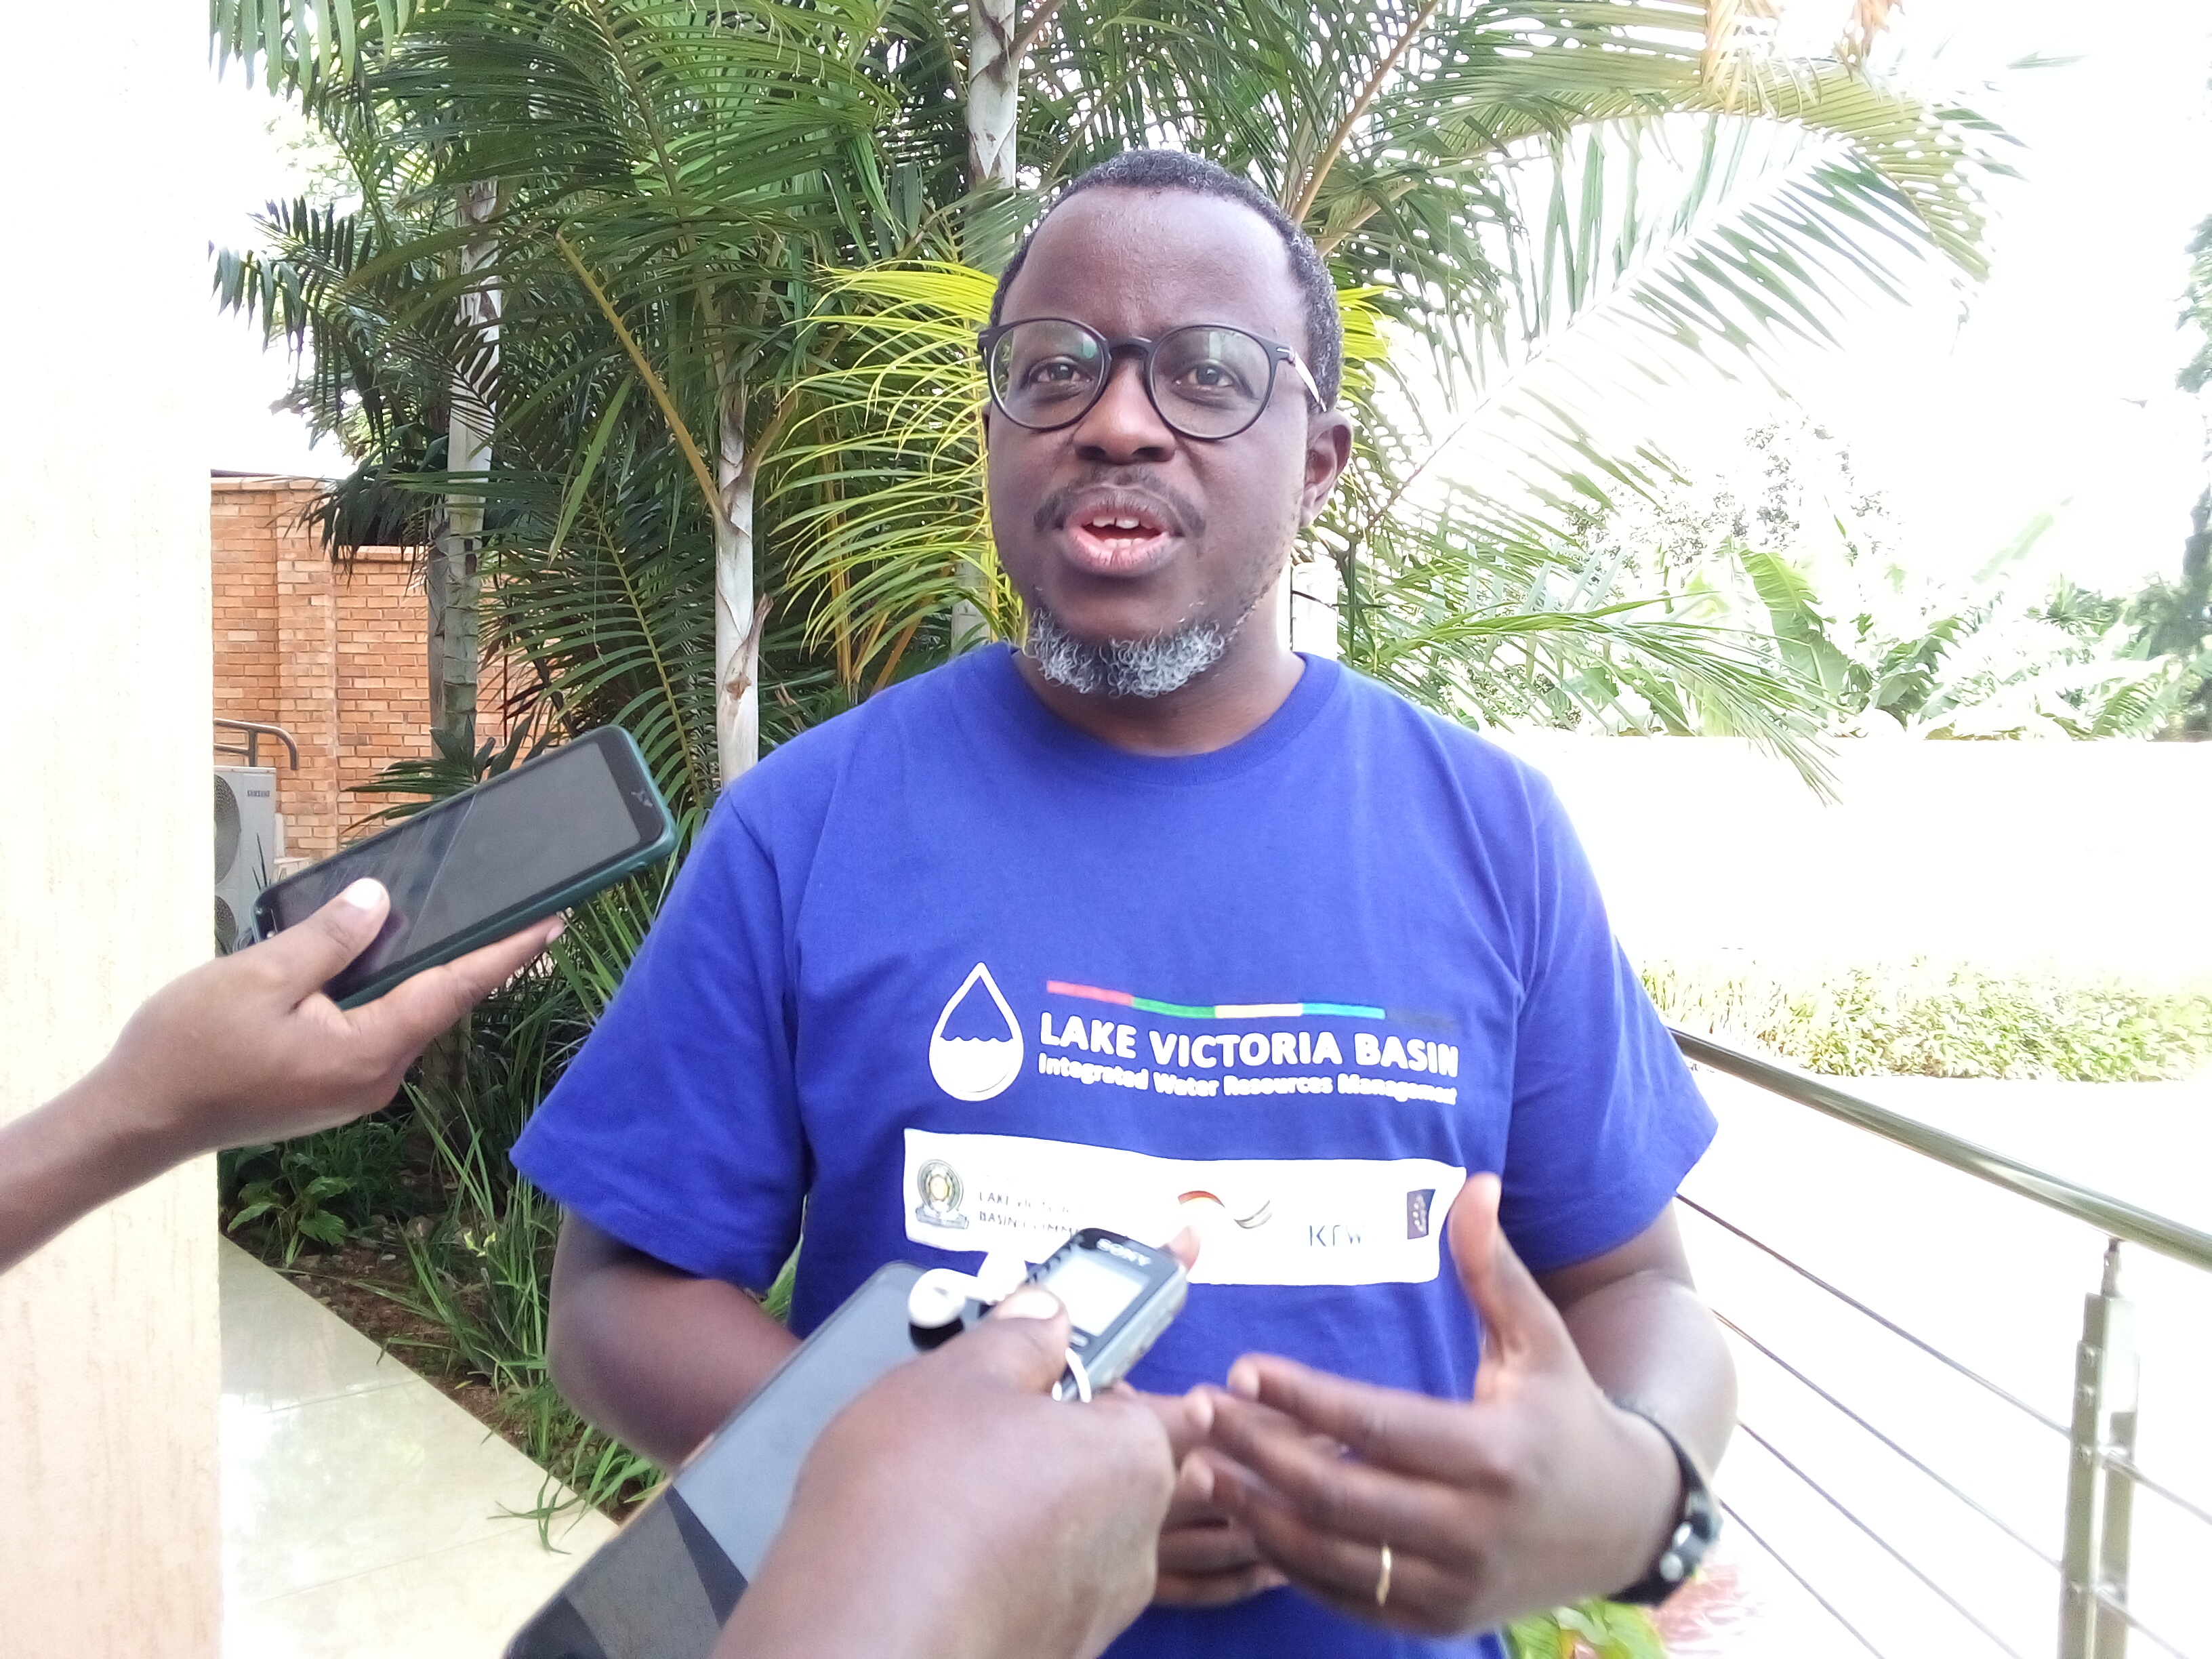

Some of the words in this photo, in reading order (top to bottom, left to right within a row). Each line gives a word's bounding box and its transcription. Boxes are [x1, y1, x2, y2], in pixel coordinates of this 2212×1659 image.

[1040, 1011, 1137, 1059] LAKE
[1148, 1030, 1344, 1069] VICTORIA
[1353, 1032, 1458, 1078] BASIN
[1038, 1052, 1149, 1090] Integrated
[1153, 1071, 1220, 1097] Water
[1223, 1074, 1334, 1097] Resources
[1337, 1073, 1458, 1105] Management
[979, 1210, 1017, 1228] BASIN
[1096, 1238, 1151, 1267] SONY
